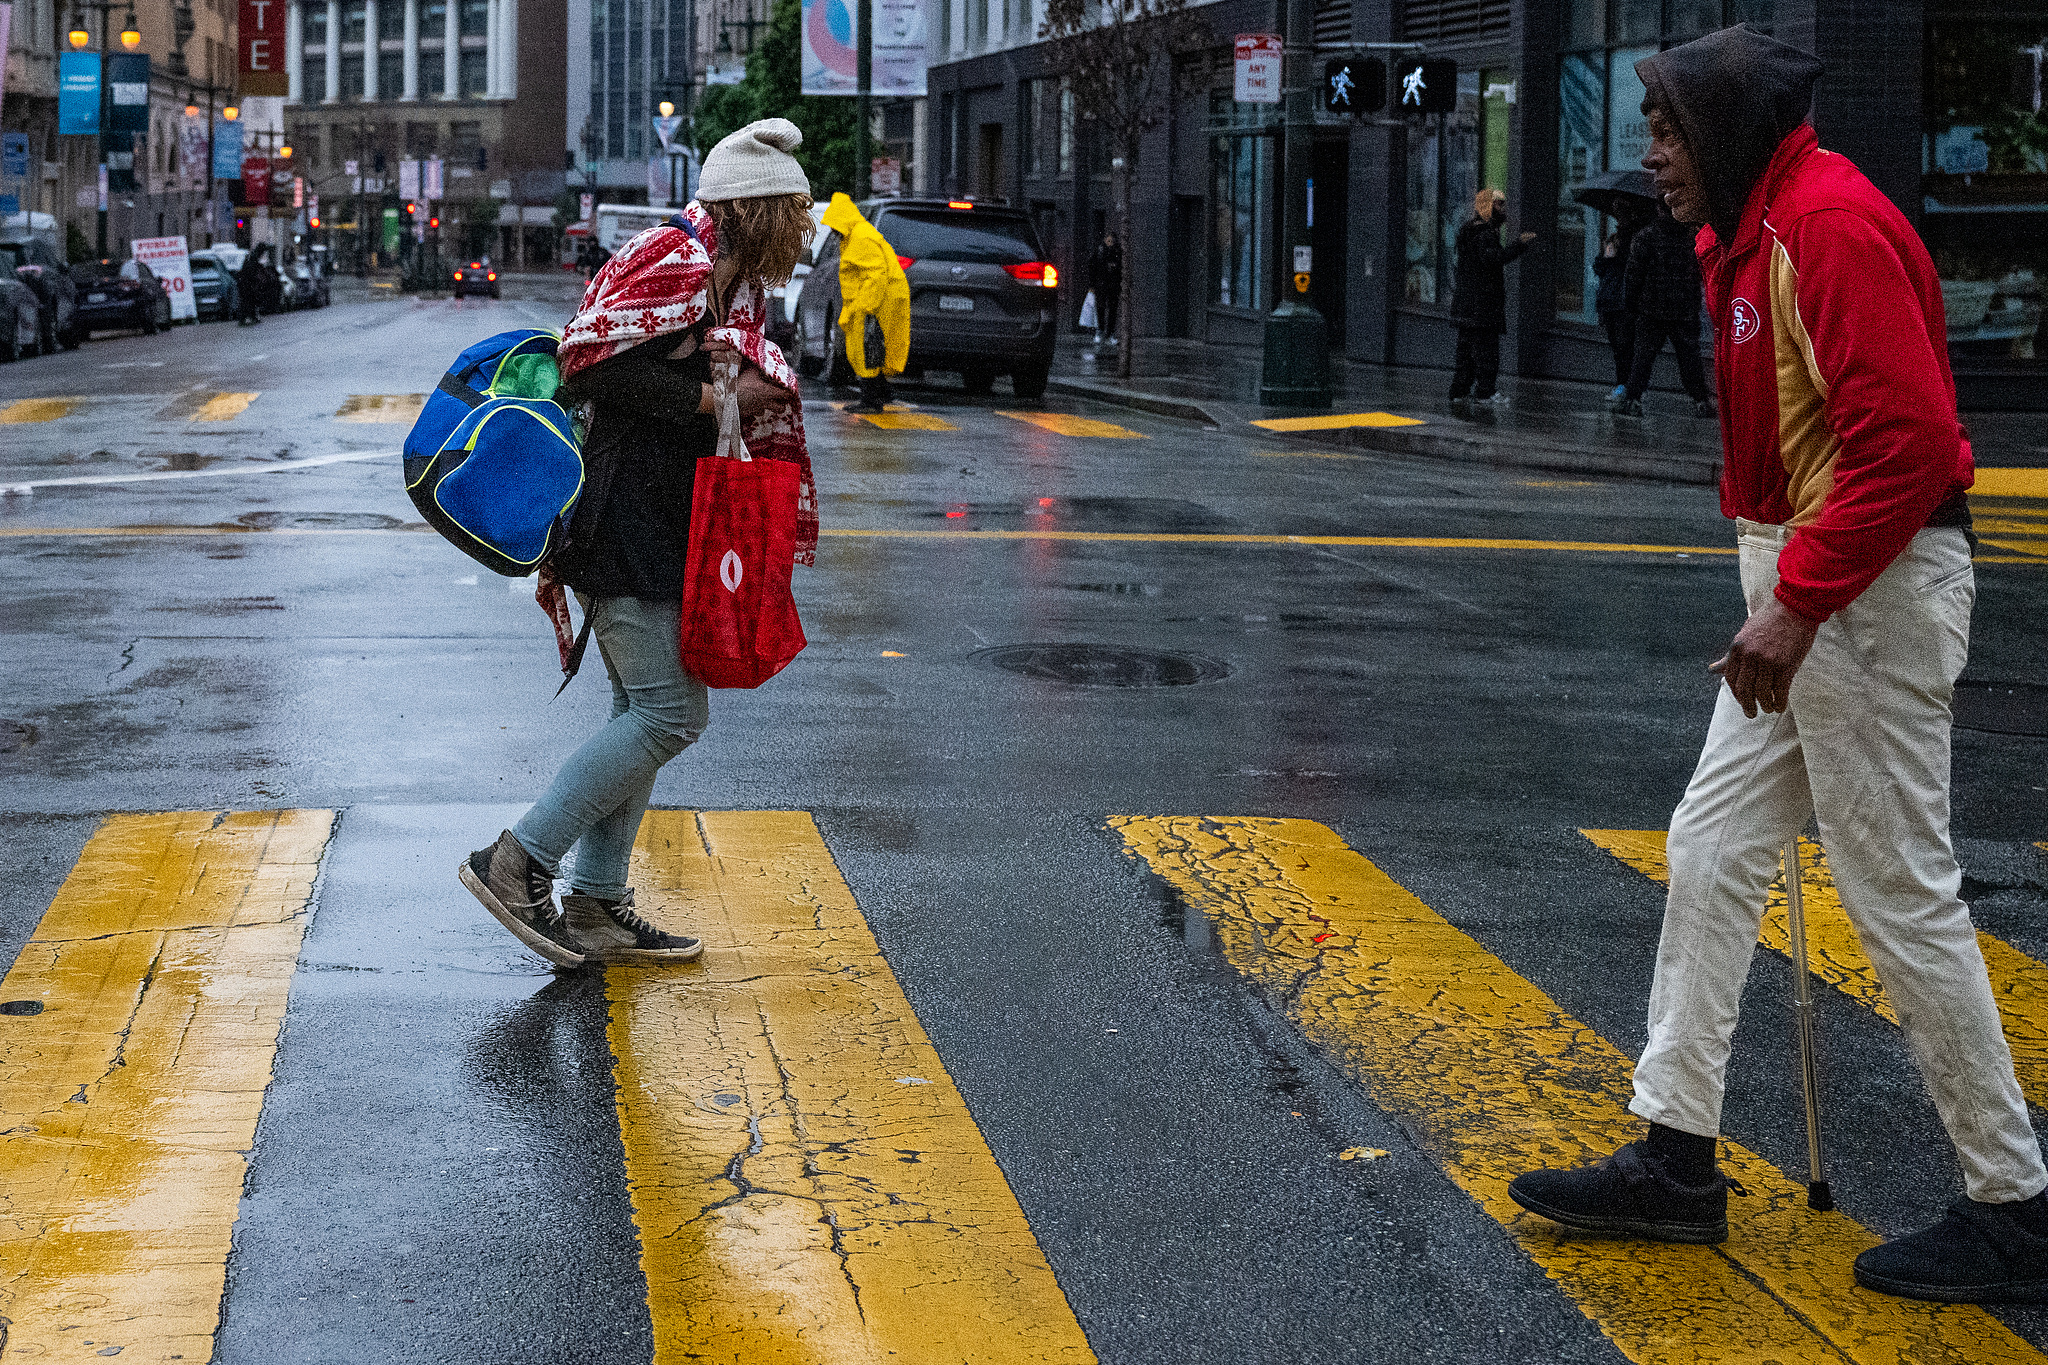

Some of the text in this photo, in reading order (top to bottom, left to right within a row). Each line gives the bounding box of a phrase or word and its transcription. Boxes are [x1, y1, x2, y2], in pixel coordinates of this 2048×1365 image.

[1249, 64, 1267, 73] ANY
[1247, 78, 1267, 88] TIME
[138, 240, 178, 250] PUBLIC
[136, 250, 185, 259] PARKING
